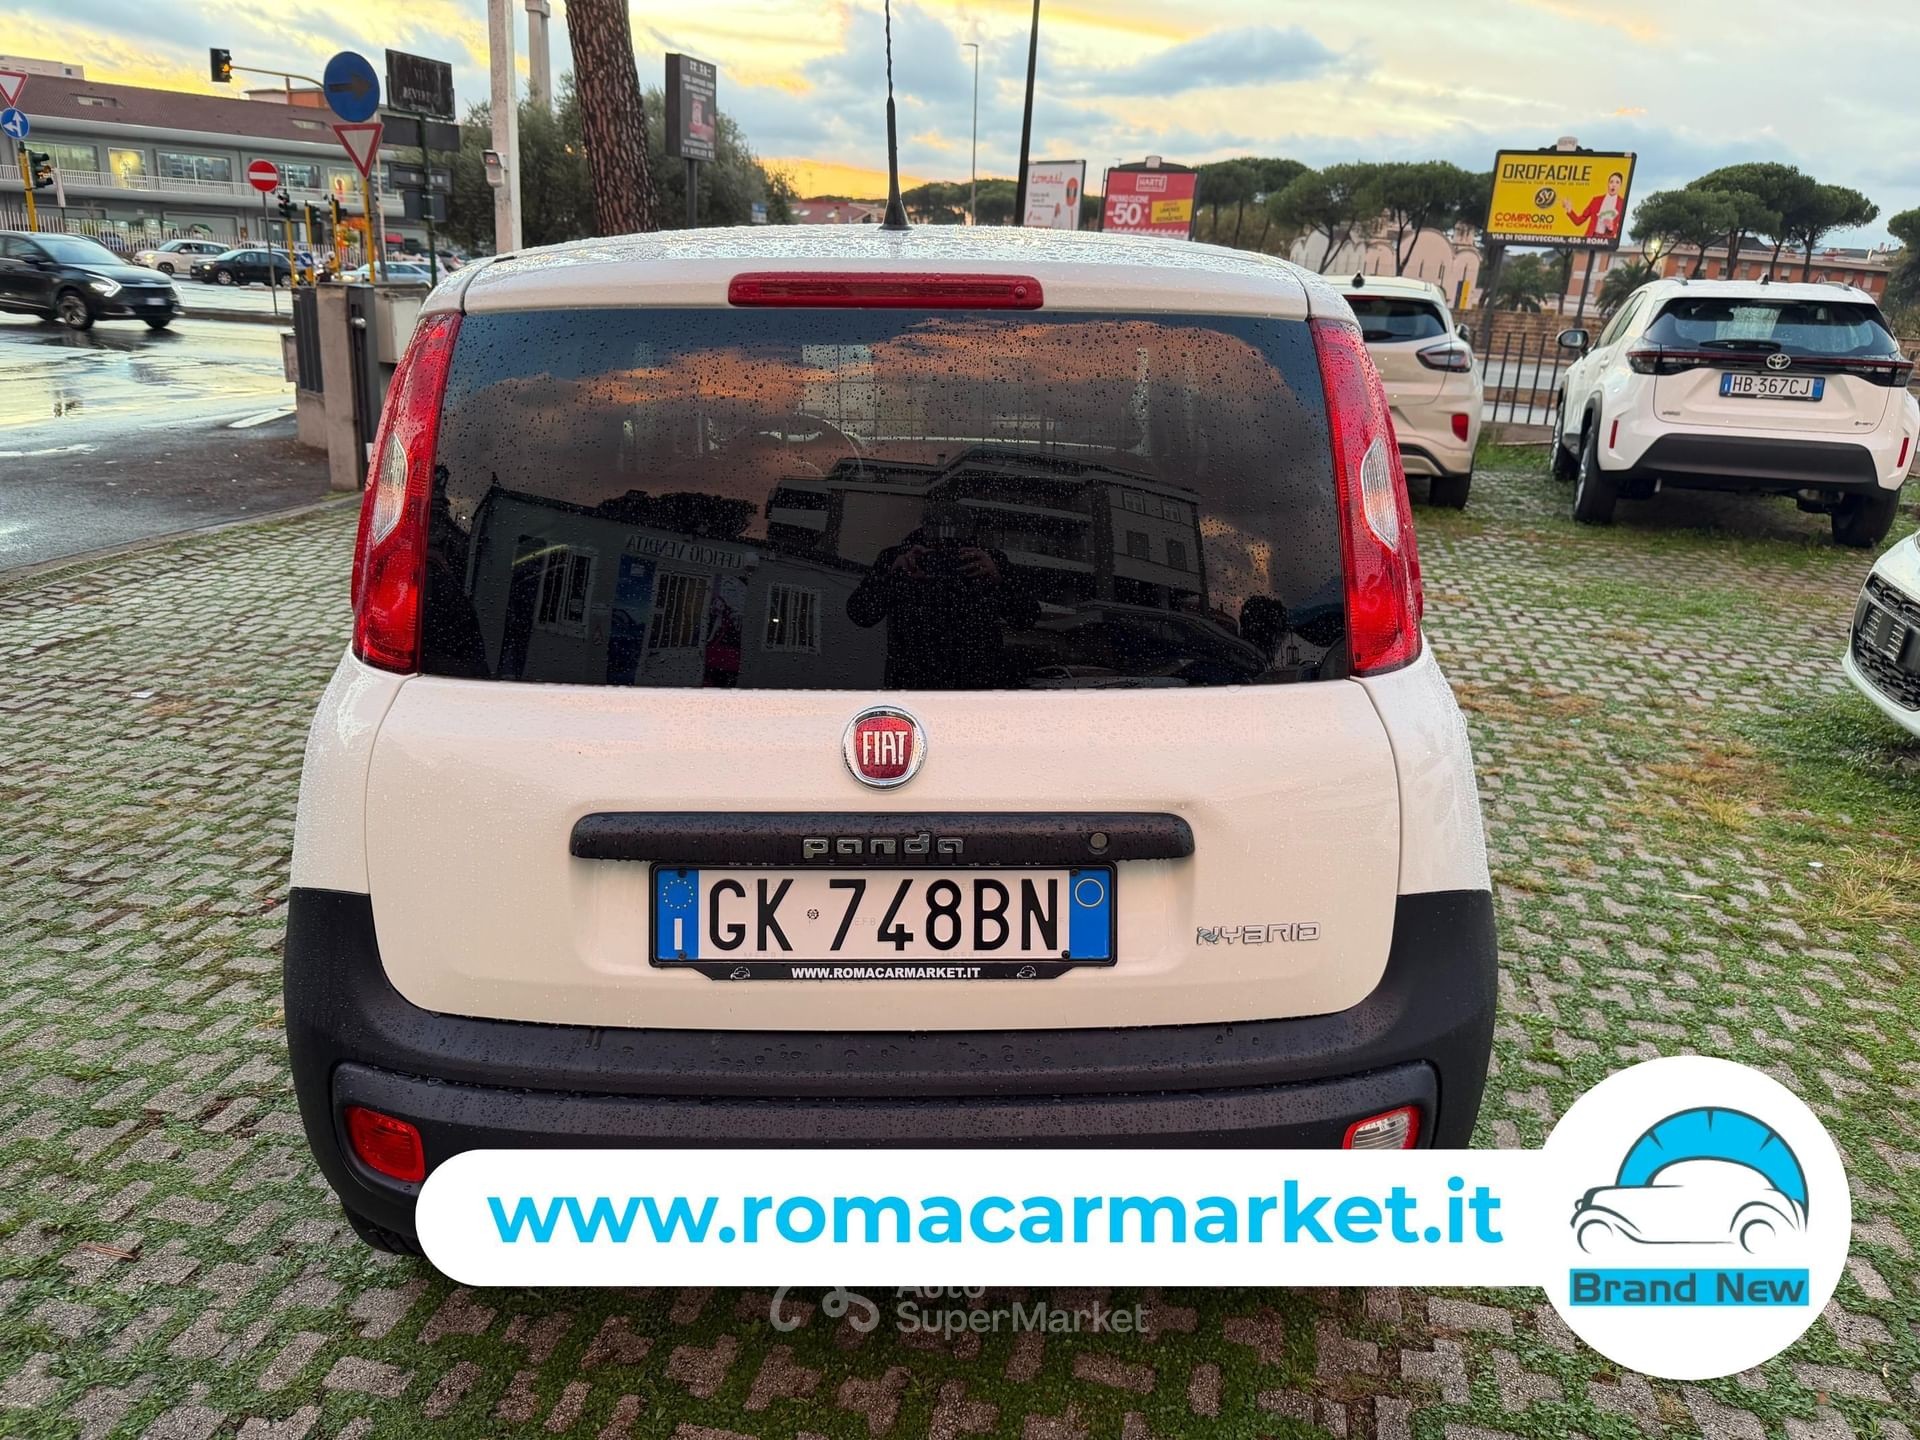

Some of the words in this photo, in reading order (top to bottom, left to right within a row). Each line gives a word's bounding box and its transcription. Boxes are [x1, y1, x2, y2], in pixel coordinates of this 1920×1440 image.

[1502, 163, 1592, 181] OROFACILE
[1506, 222, 1553, 230] CONTANTI
[1586, 237, 1609, 245] ROMA
[1732, 376, 1753, 392] HB
[1758, 377, 1810, 395] 367CJ
[862, 731, 908, 765] FIAT
[803, 833, 964, 858] panda
[674, 918, 682, 950] I
[709, 879, 793, 951] GK
[829, 878, 1058, 951] 748BN
[1197, 922, 1321, 945] HYBRID
[791, 967, 981, 979] WWW.ROMACARMARKET.IT
